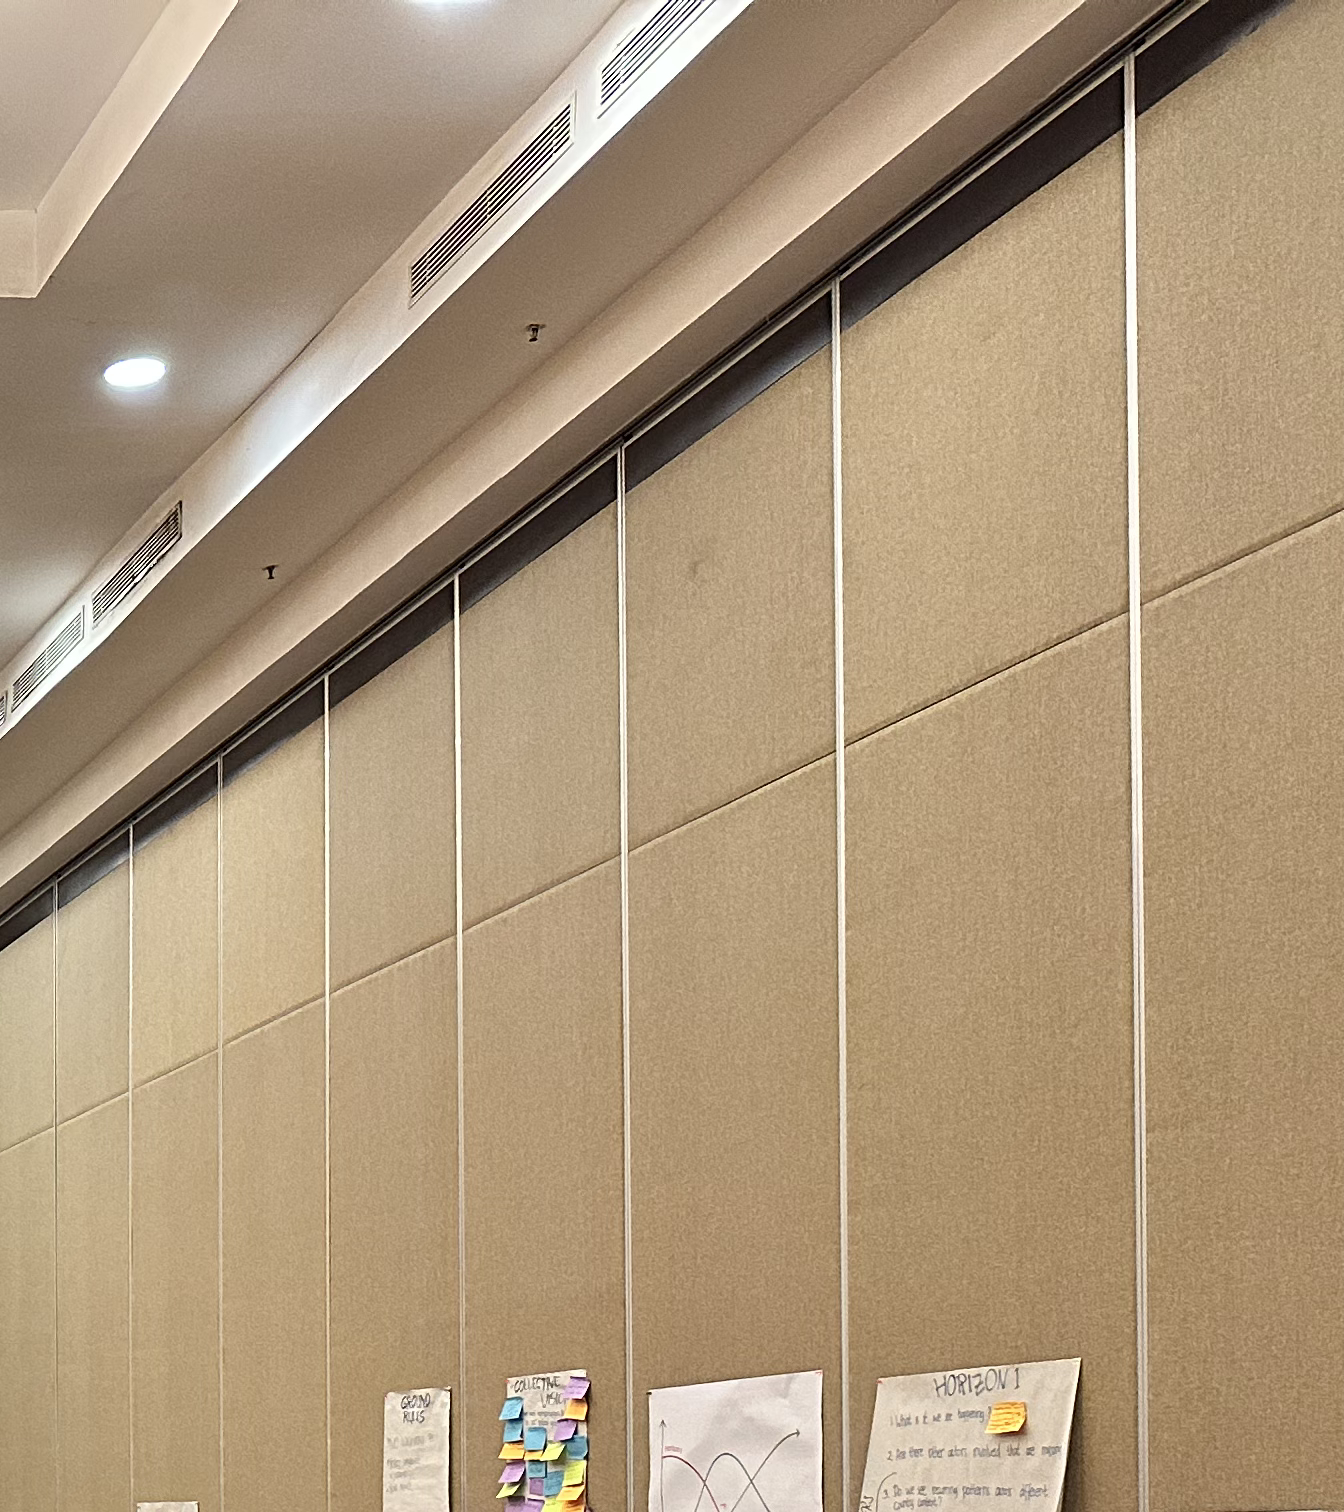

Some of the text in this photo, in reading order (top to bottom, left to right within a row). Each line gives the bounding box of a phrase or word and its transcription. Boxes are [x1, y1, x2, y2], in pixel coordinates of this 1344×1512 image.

[514, 1375, 560, 1393] COLLECTIVE
[933, 1368, 1009, 1398] HORIZON
[400, 1392, 431, 1410] GROUND
